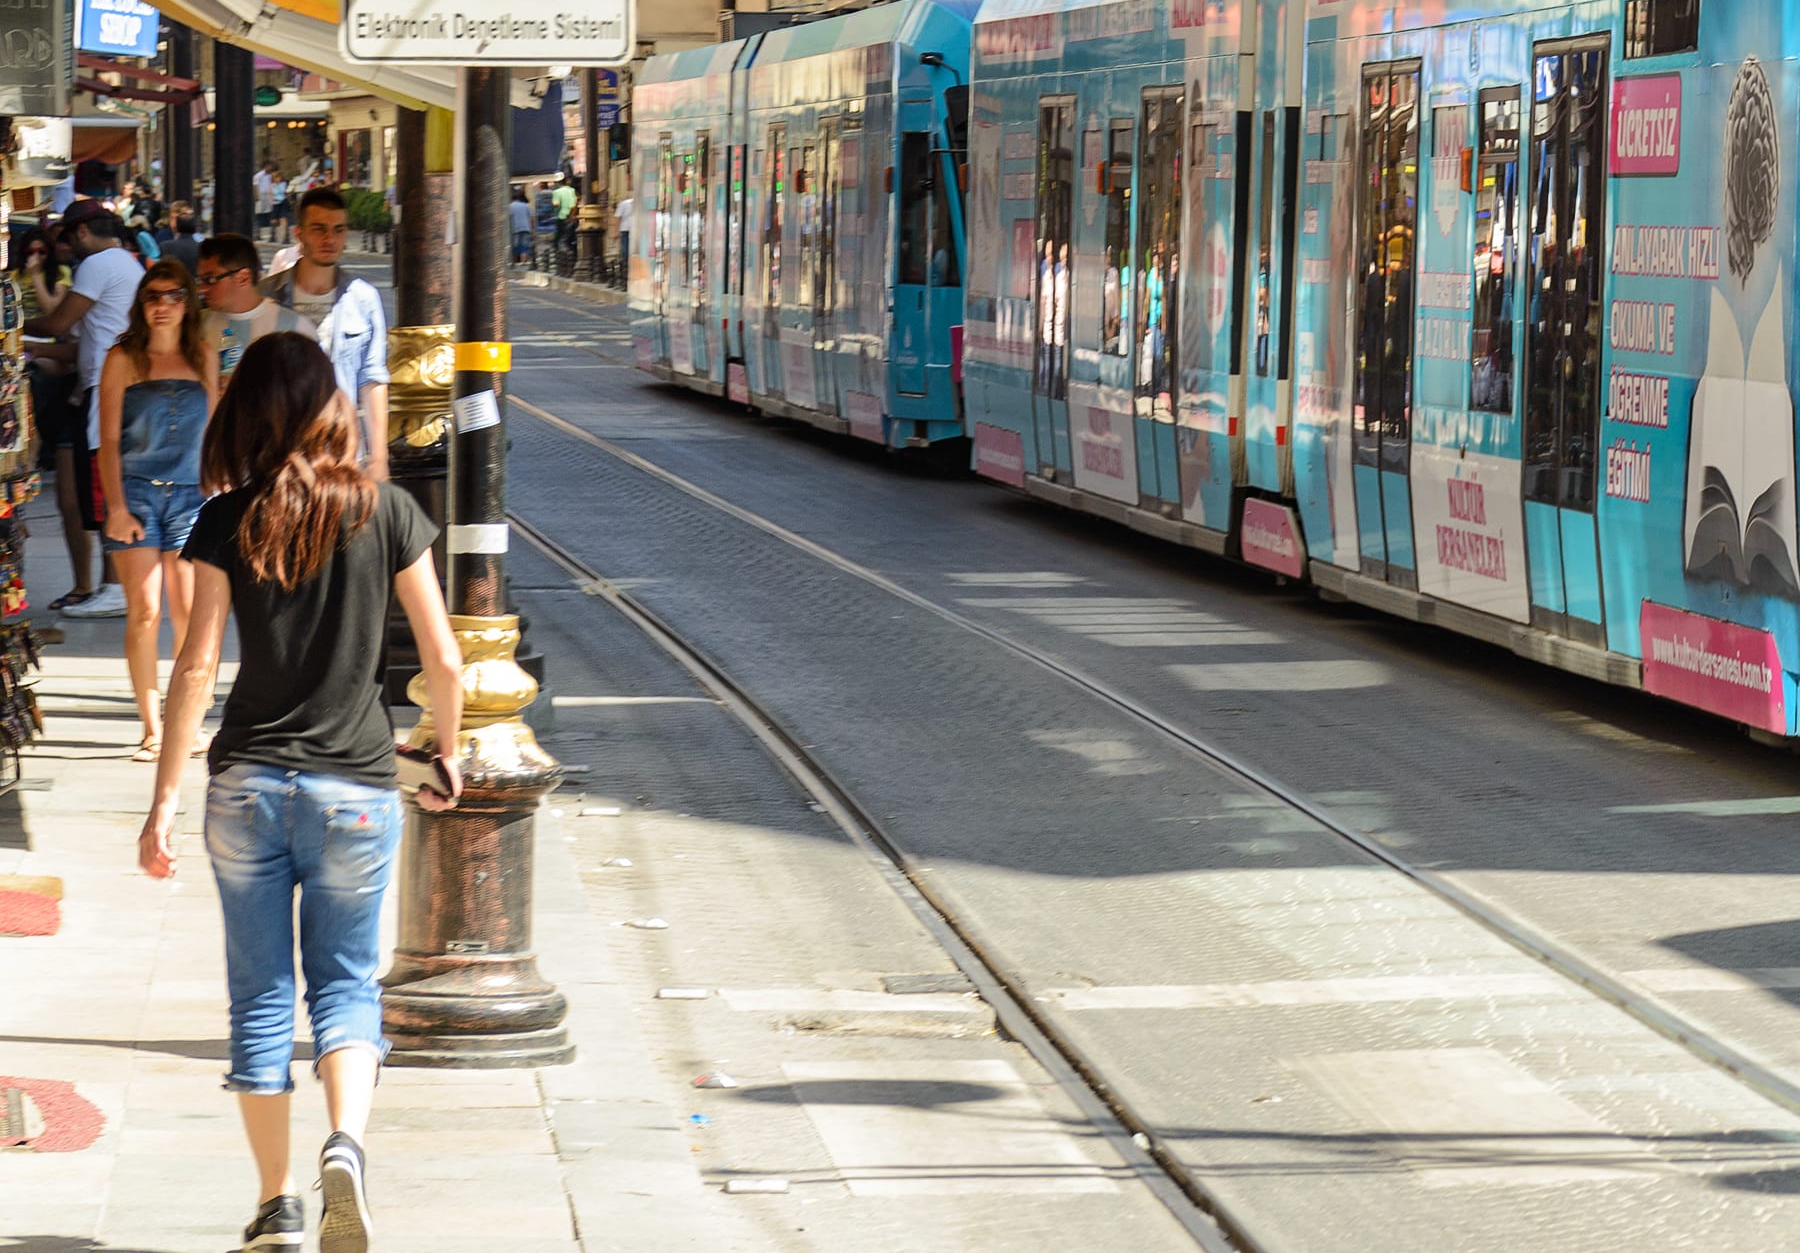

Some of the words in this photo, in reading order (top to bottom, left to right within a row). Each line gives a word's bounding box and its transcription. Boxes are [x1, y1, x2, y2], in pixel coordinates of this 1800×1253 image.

[355, 12, 448, 39] Elektronik
[555, 12, 621, 39] Sistemi
[1616, 92, 1678, 158] ÜCRETSİZ
[1612, 225, 1686, 278] ANLAYARAK
[1688, 227, 1720, 280] HIZLI
[1611, 300, 1656, 353] OKUMA
[1658, 303, 1675, 355] VE
[1607, 364, 1669, 429] ÖĞRENME
[1606, 438, 1651, 503] EĞİTİMİ
